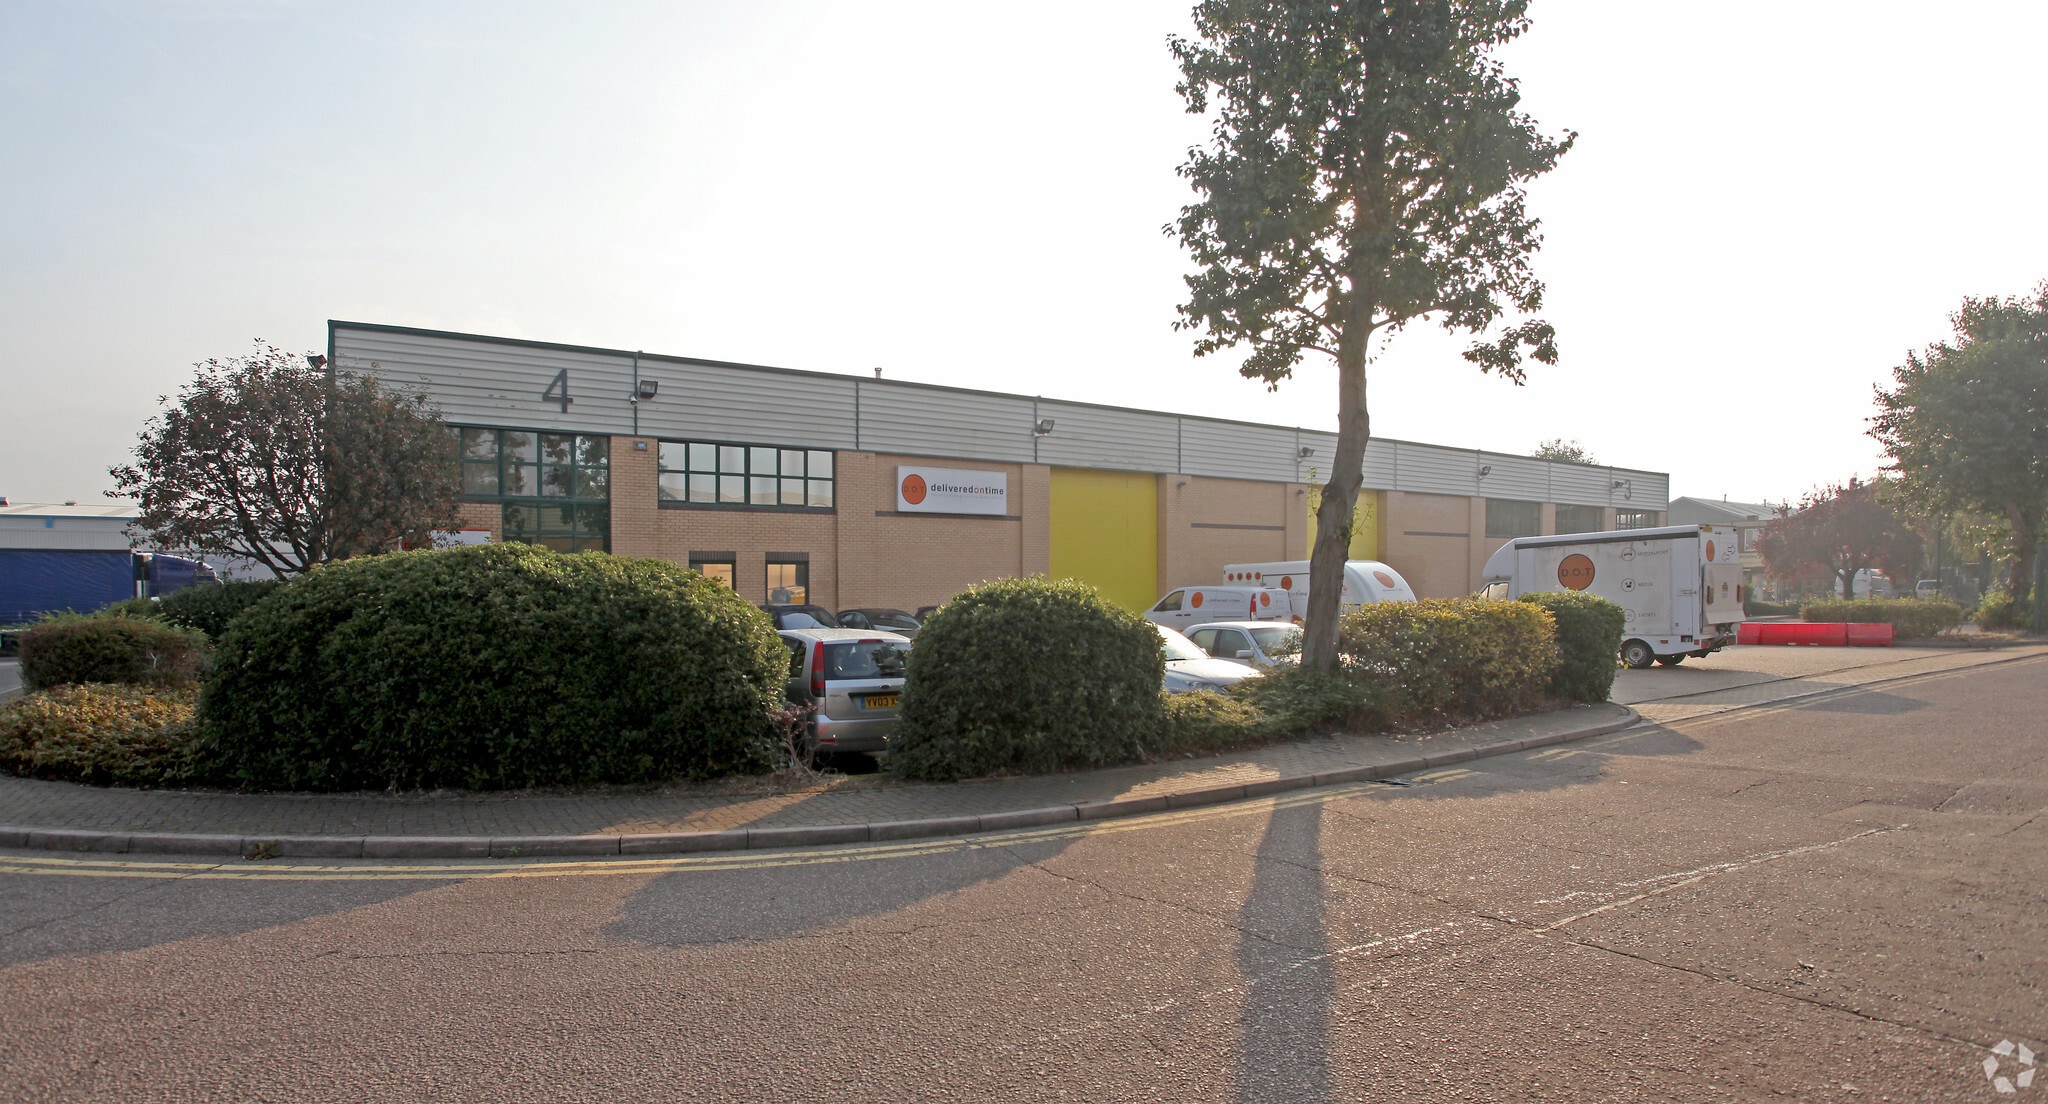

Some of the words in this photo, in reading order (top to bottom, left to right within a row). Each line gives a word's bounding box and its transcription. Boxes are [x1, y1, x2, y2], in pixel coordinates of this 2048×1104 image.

[542, 368, 574, 414] 4
[930, 483, 1005, 495] deliveredontime
[1624, 479, 1632, 501] 3
